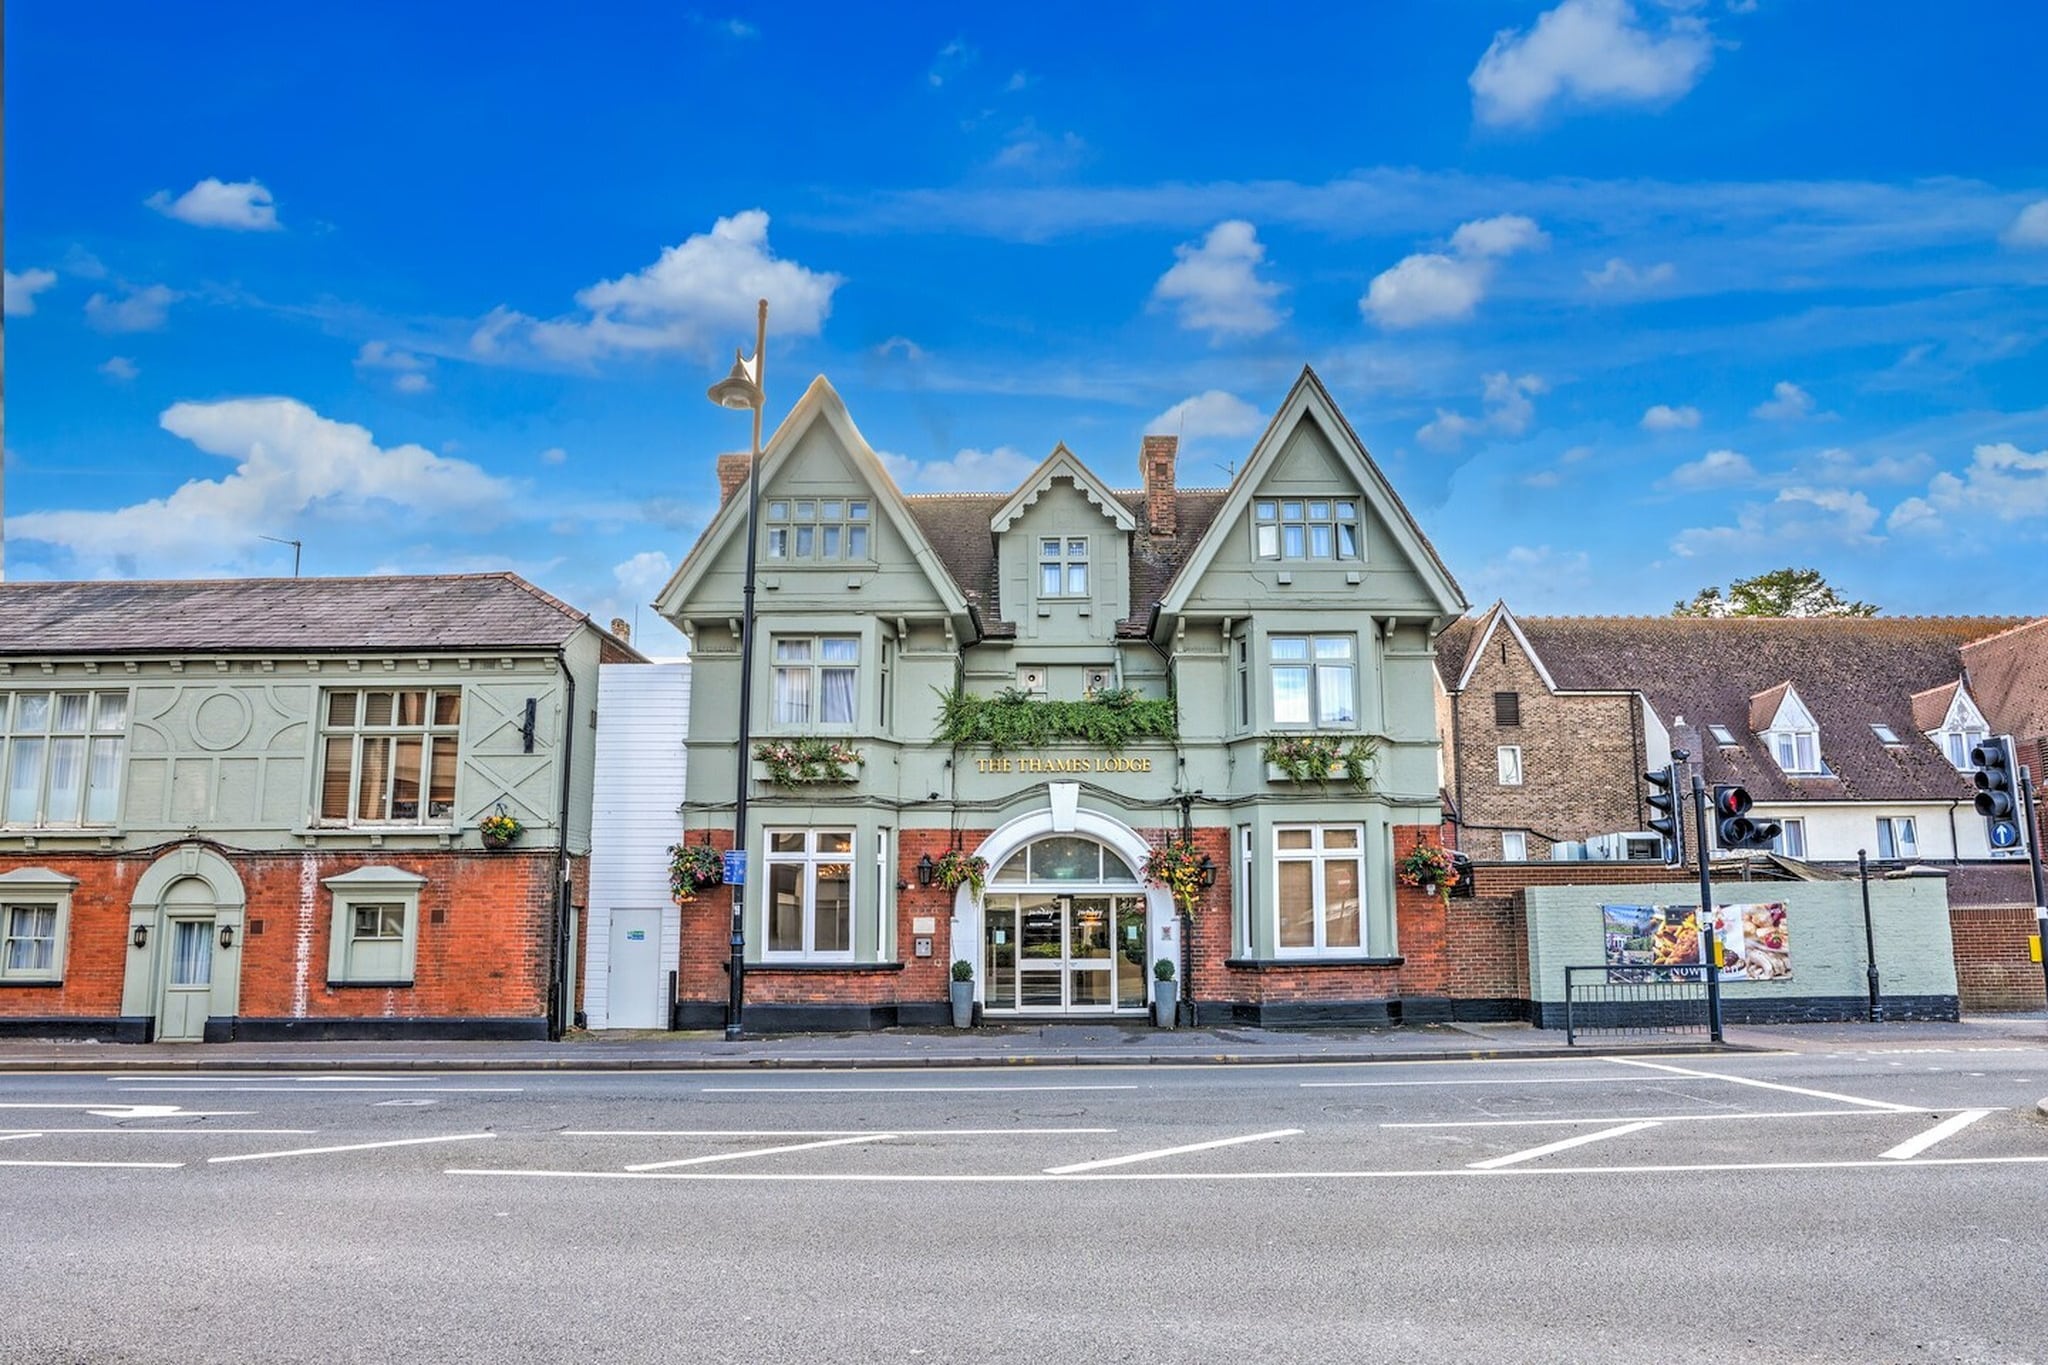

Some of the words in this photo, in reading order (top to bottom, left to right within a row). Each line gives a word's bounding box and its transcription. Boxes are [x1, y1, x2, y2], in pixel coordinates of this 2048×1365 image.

[976, 757, 1012, 773] THE
[1016, 757, 1091, 773] THAMES
[1094, 756, 1152, 773] LODGE
[1669, 966, 1700, 977] NOW
